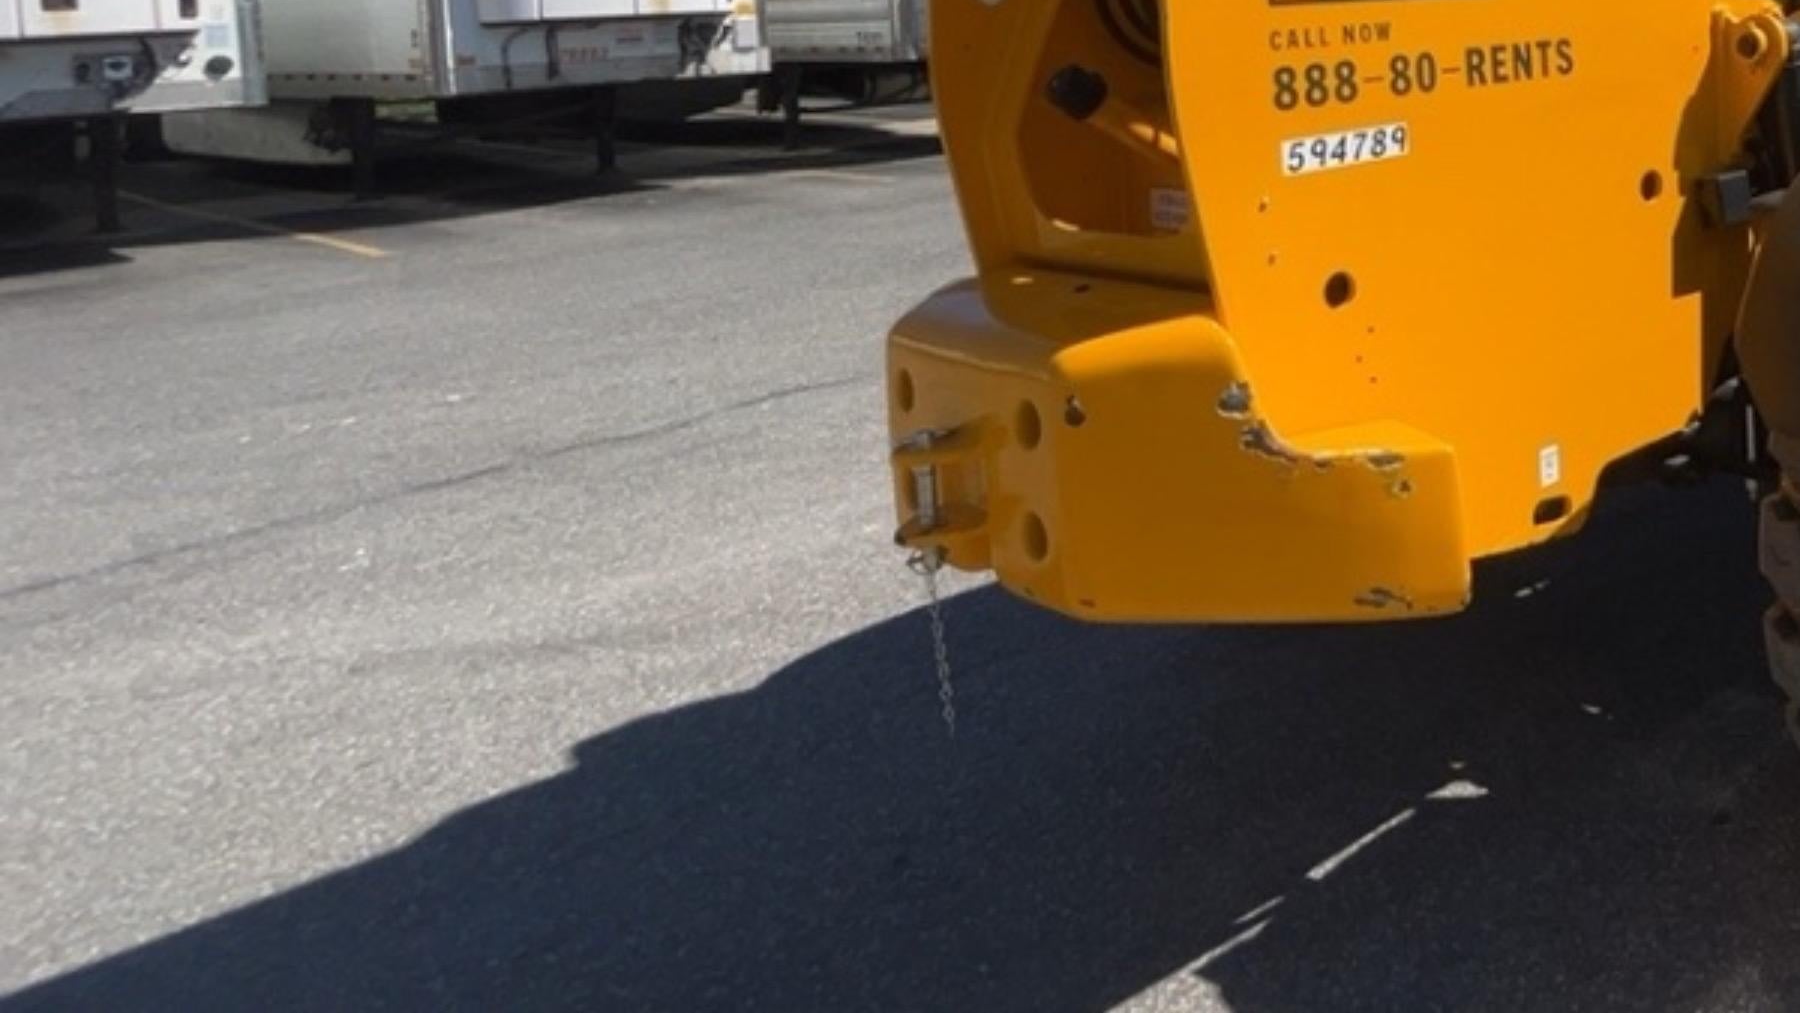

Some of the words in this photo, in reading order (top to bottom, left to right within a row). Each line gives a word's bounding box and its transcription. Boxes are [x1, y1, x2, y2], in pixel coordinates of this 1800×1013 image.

[1268, 26, 1330, 51] CALL
[1342, 21, 1392, 43] NOW
[1273, 37, 1574, 110] 888-80-RENTS
[1286, 126, 1407, 172] 594789
